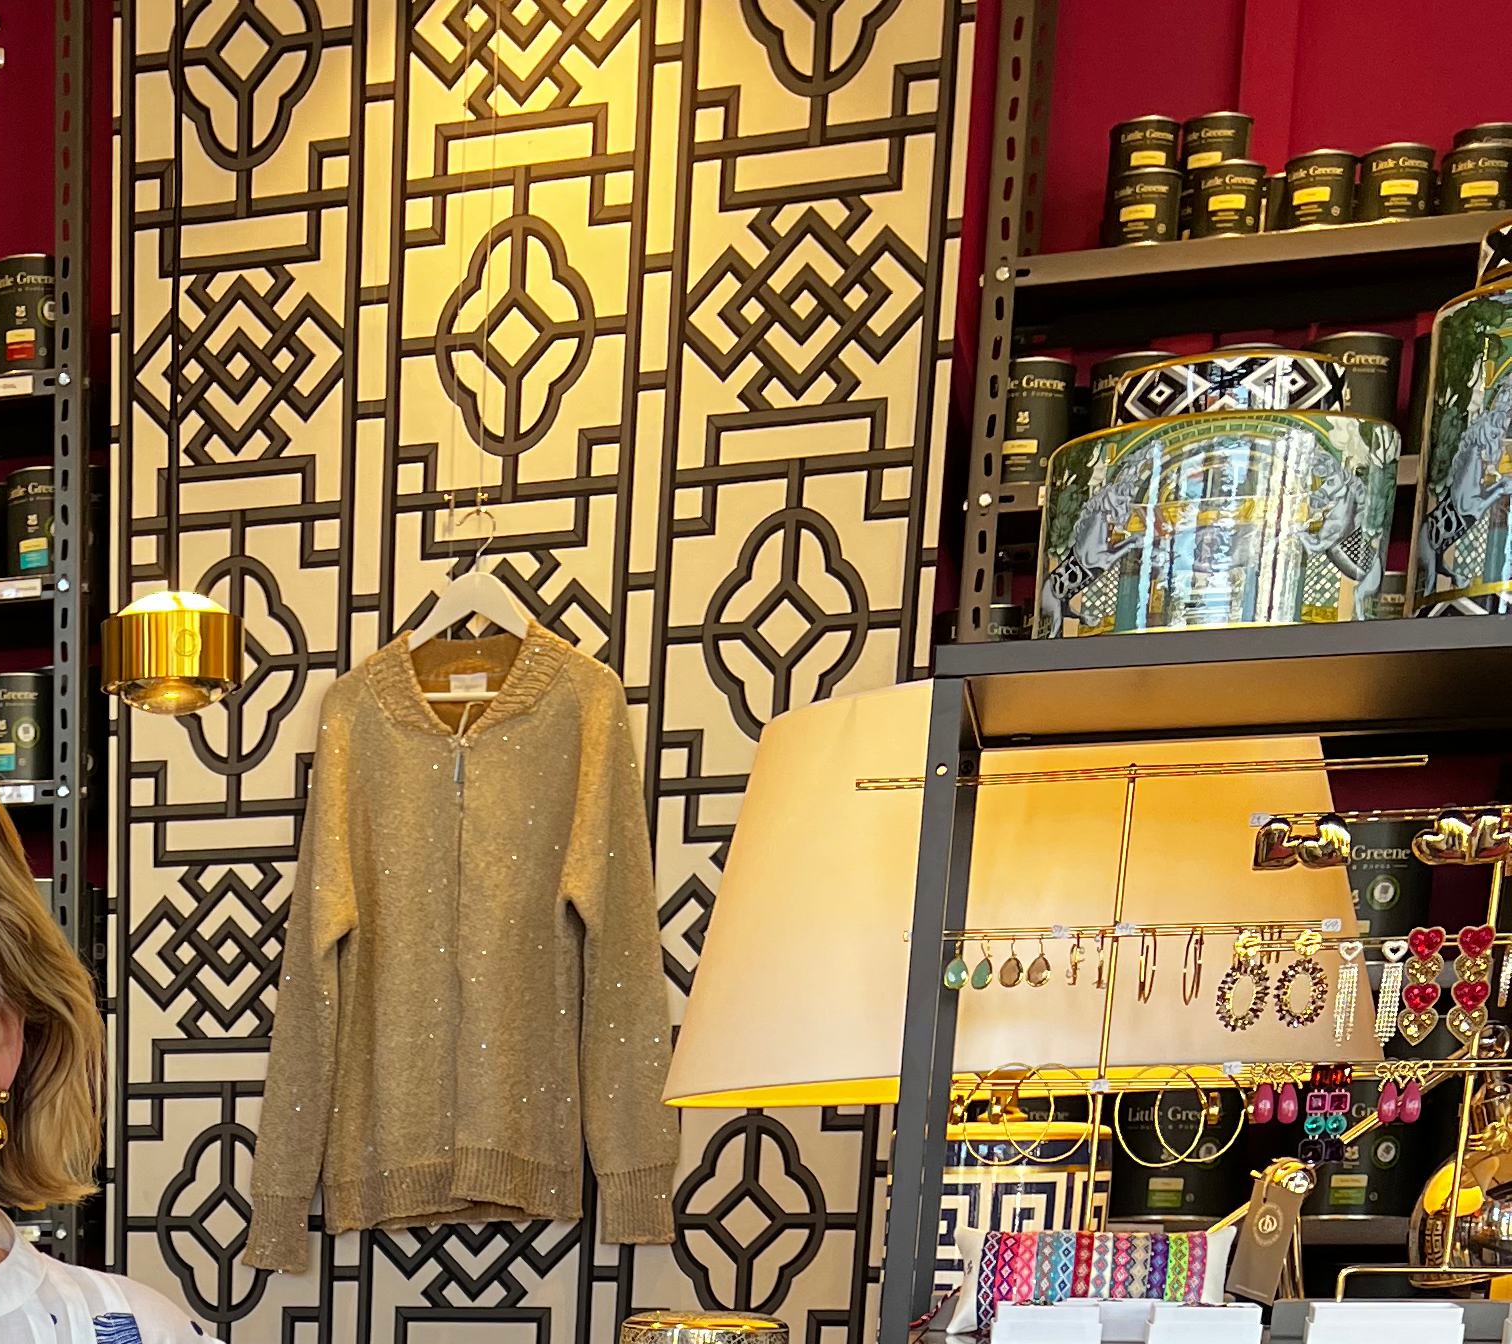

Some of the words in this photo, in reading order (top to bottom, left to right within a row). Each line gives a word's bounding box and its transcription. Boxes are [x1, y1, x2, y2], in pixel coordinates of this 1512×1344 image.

[1145, 128, 1174, 141] Greene
[1200, 127, 1235, 140] Greene
[1399, 156, 1429, 170] Greene
[1308, 164, 1344, 178] Greene
[1224, 174, 1258, 187] Greene
[1343, 351, 1390, 367] Greene
[1021, 374, 1067, 391] Greene
[1351, 844, 1410, 864] Greene
